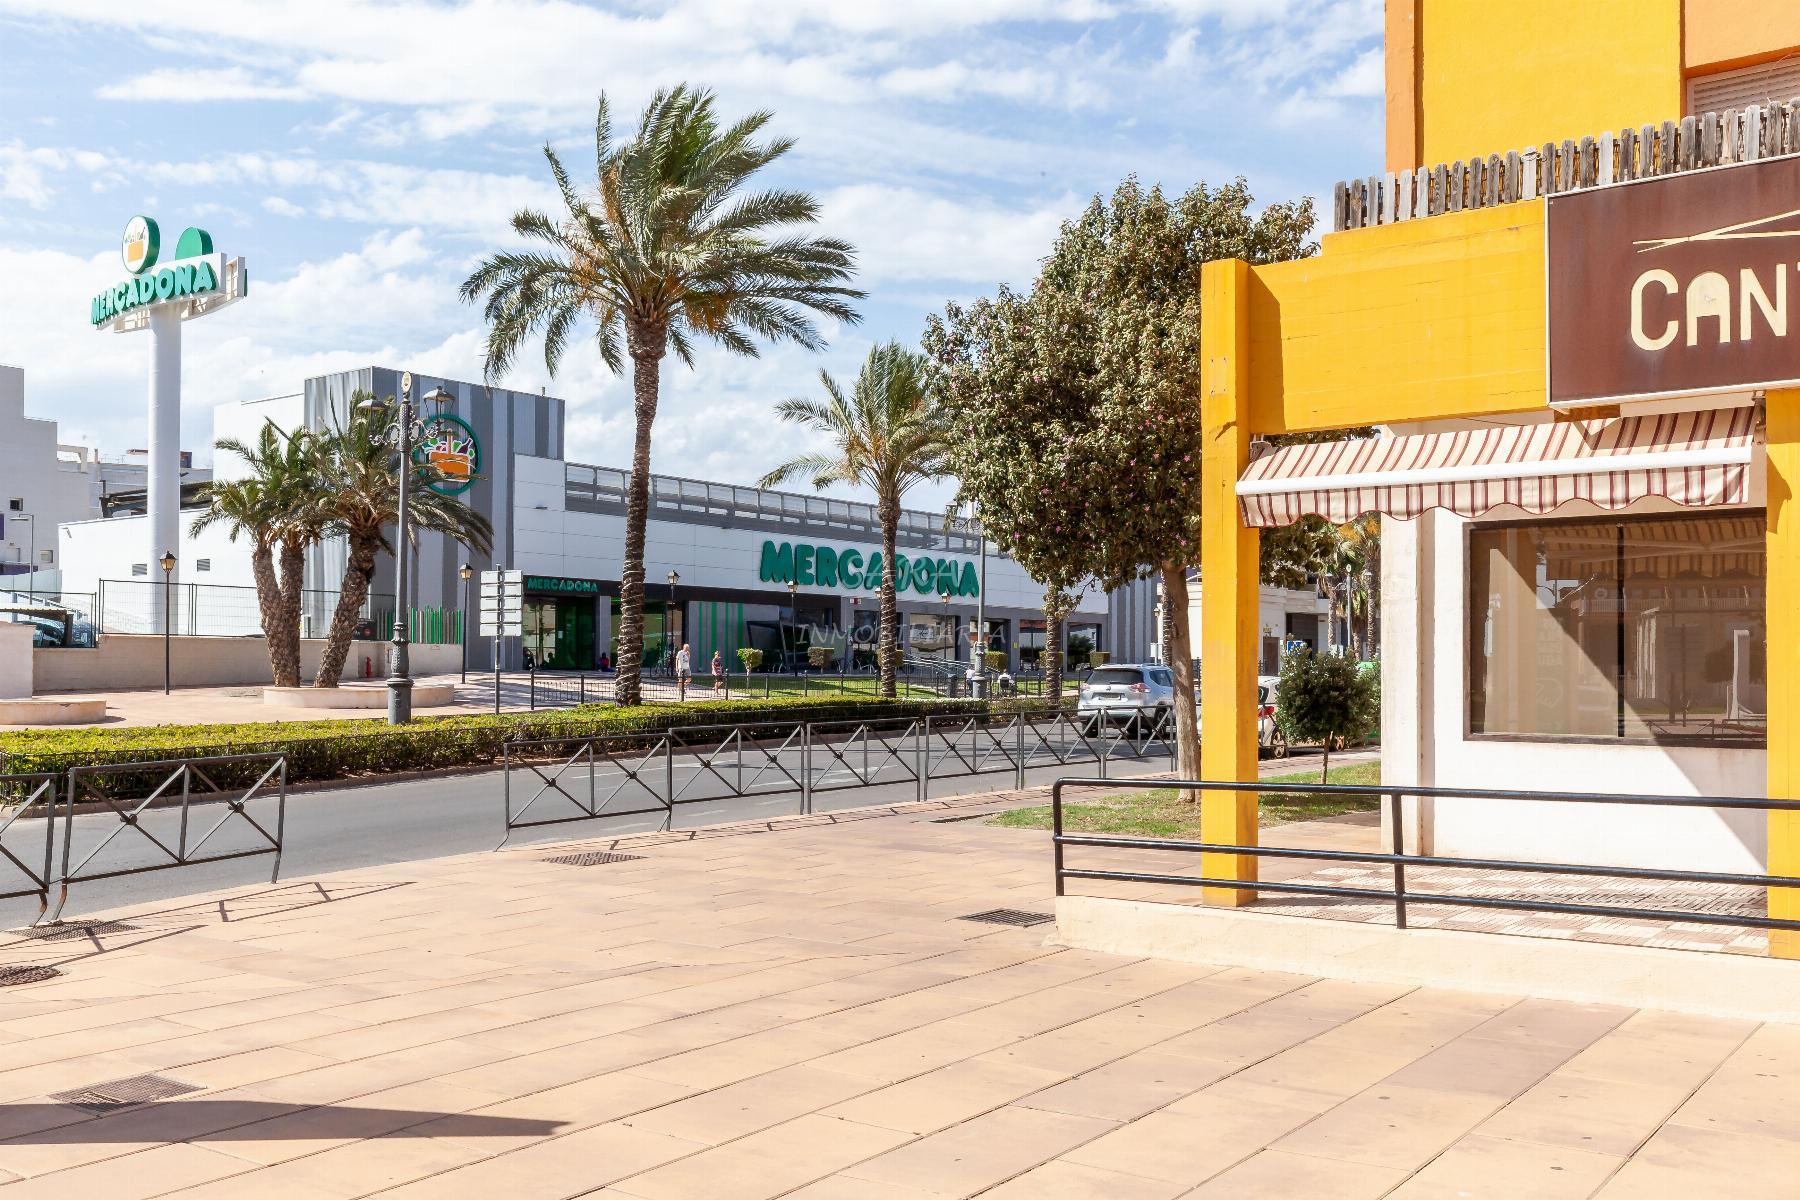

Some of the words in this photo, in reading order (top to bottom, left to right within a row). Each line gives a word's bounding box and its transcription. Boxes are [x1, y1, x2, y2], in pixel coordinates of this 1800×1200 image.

[91, 261, 217, 325] MERCADONA
[1630, 262, 1800, 351] CAN
[527, 577, 598, 592] MERCADONA
[760, 540, 980, 598] MERCADONA
